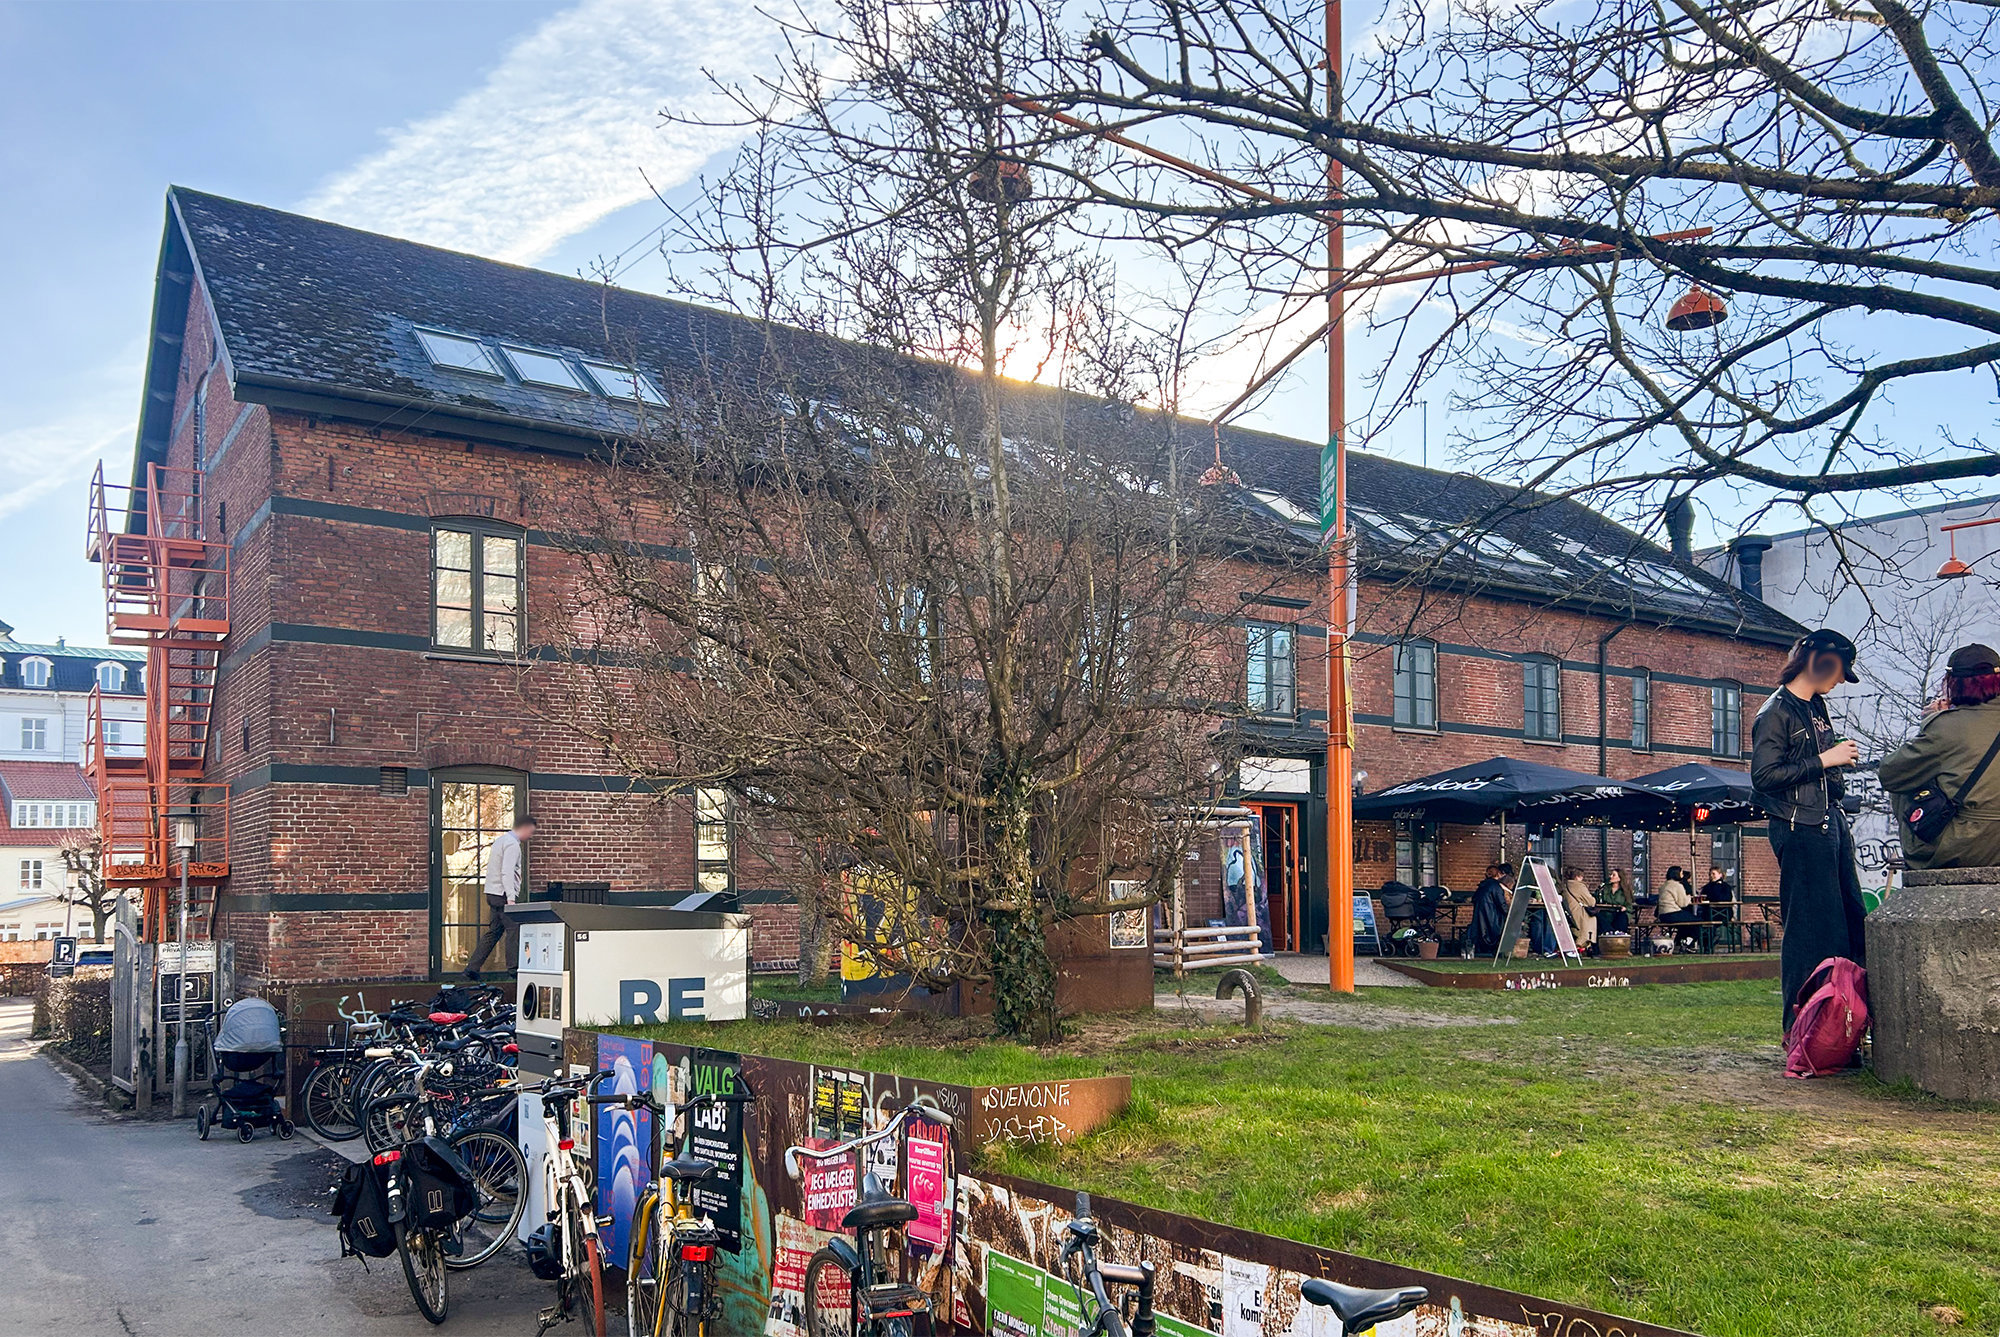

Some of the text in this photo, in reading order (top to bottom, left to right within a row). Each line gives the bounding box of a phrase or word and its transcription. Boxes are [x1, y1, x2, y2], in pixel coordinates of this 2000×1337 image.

[60, 943, 70, 959] P
[619, 977, 706, 1026] RE
[694, 1064, 735, 1096] VALG
[694, 1101, 727, 1133] LAB!
[810, 1172, 824, 1191] JEG
[824, 1168, 855, 1189] VÆLGER
[807, 1188, 858, 1211] ENHEDSLISTEN
